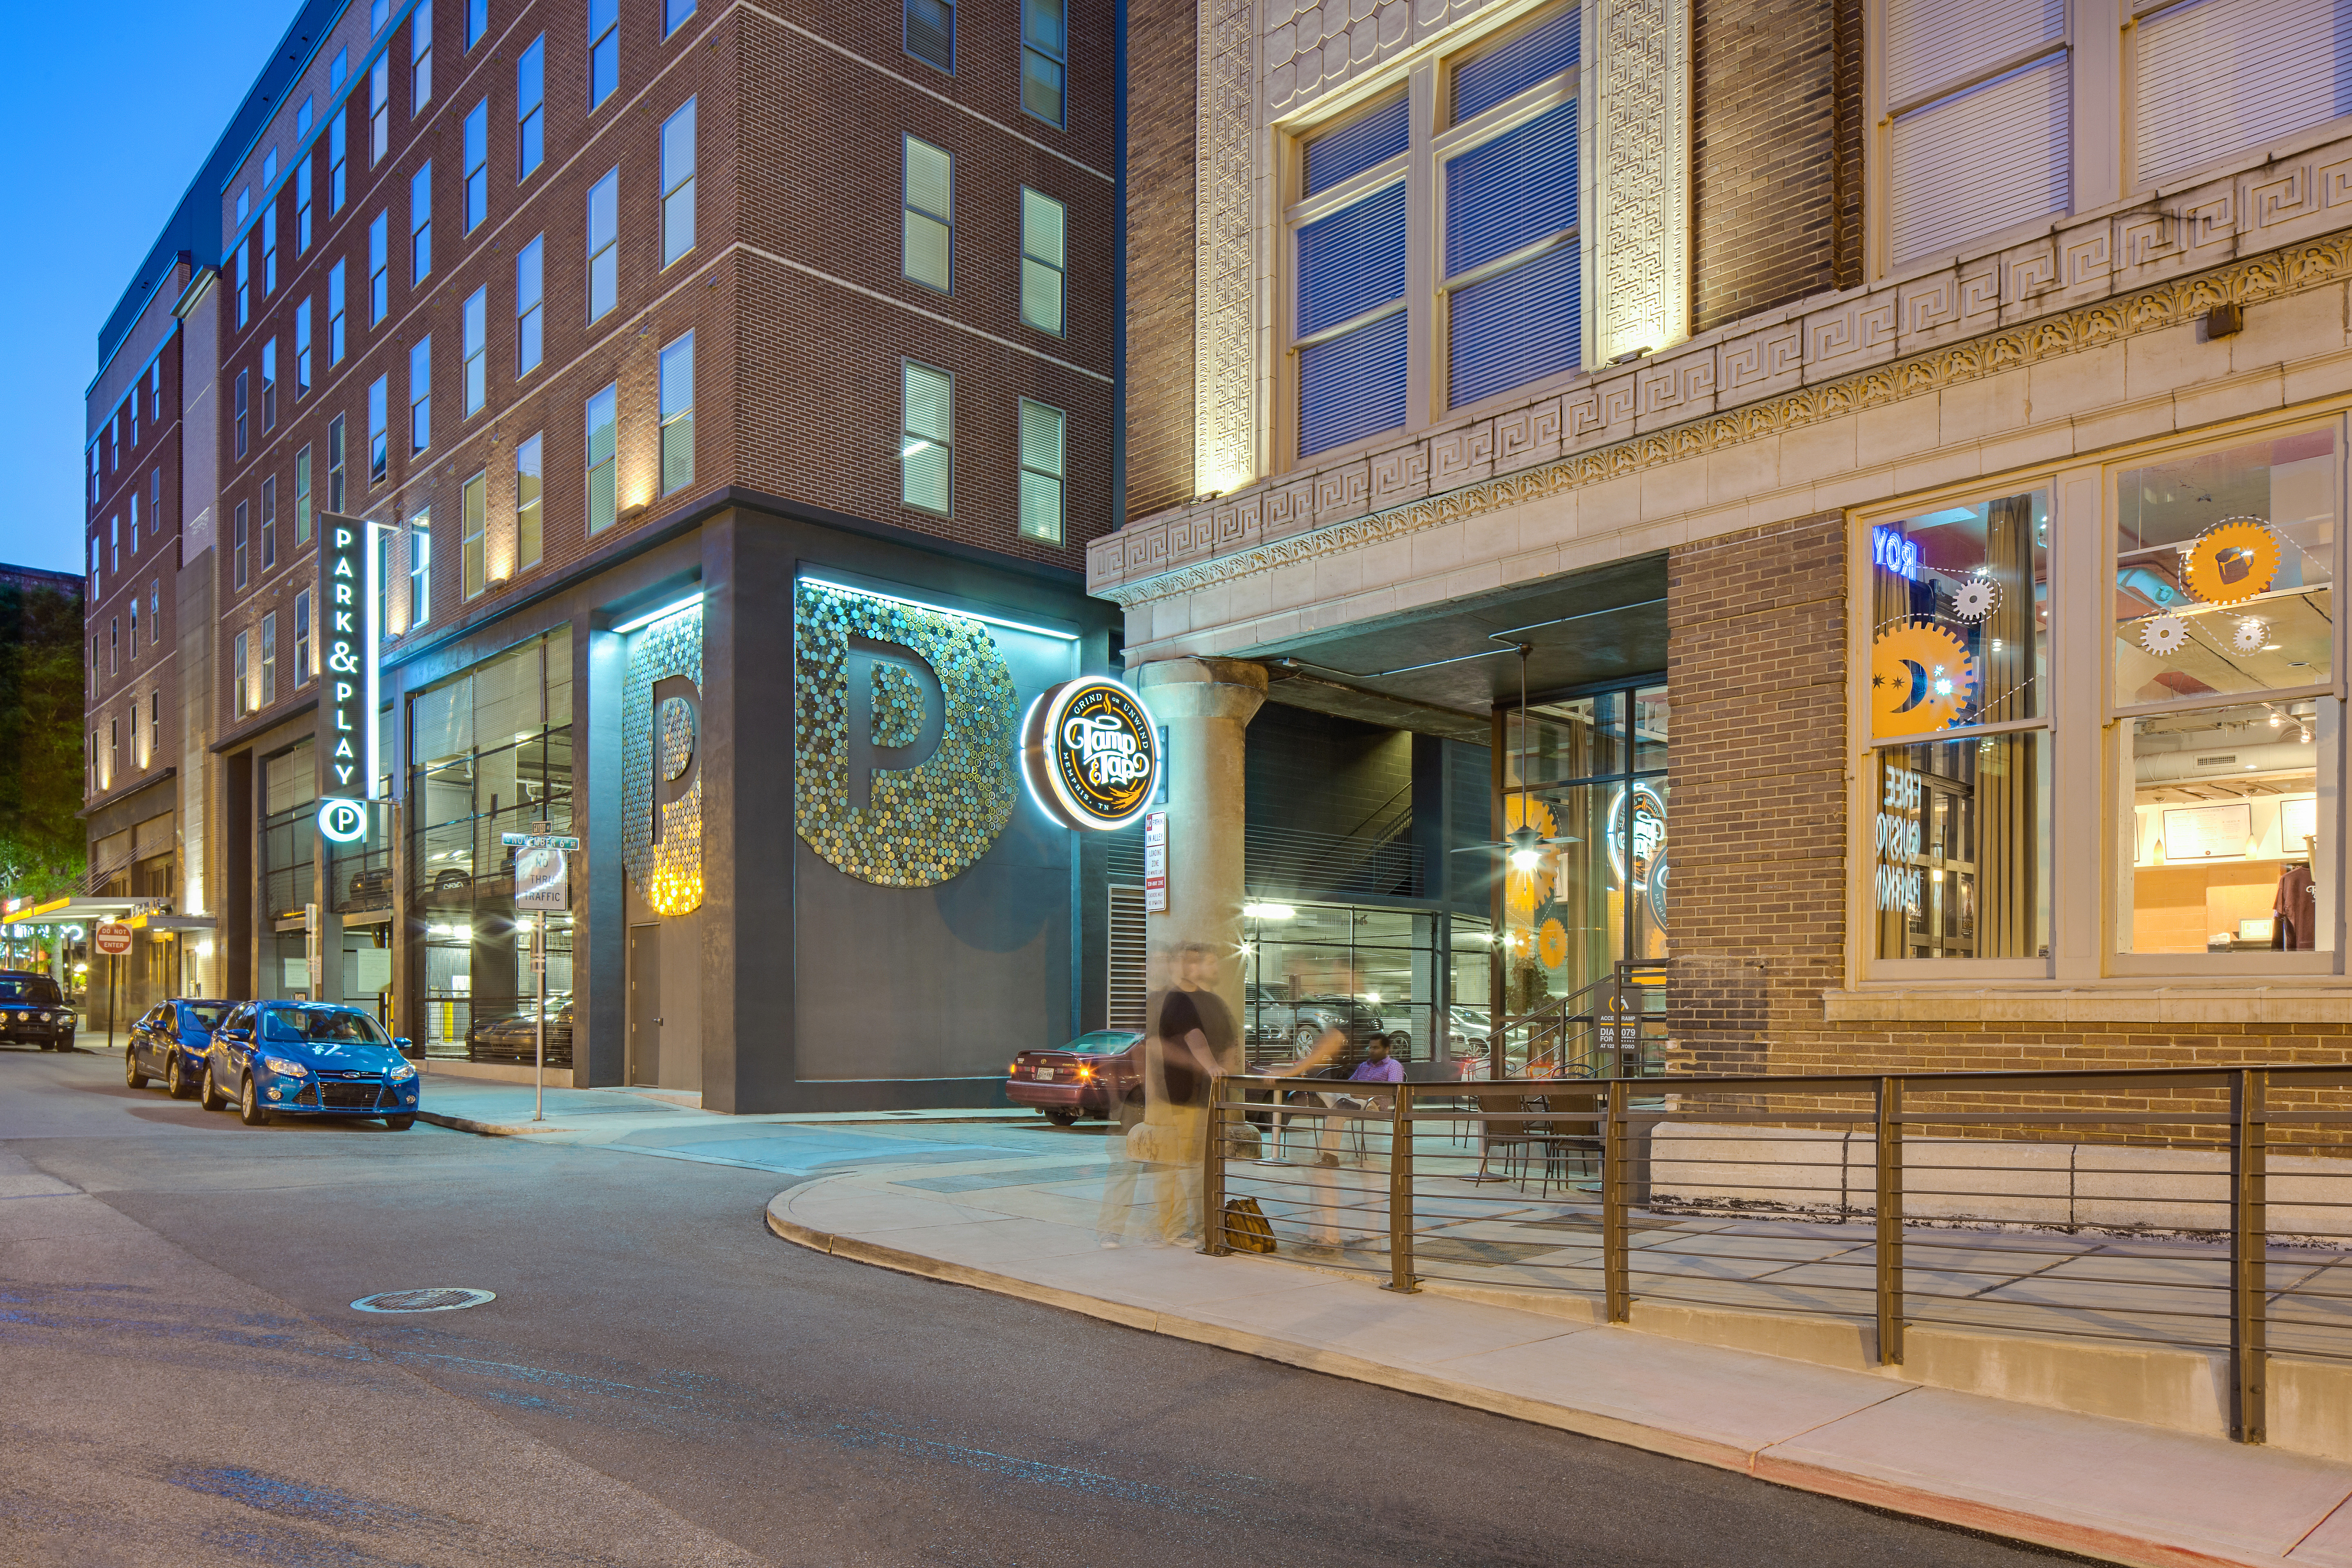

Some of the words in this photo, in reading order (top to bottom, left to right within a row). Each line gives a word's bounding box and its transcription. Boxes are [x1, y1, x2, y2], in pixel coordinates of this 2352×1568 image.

[1074, 693, 1102, 714] GRIND
[1123, 703, 1149, 749] UNWIND
[1064, 715, 1136, 761] Tamp
[1083, 750, 1150, 785] Tap
[1098, 803, 1109, 811] TN
[533, 823, 546, 833] GAYOSO
[1147, 819, 1152, 828] NO
[512, 837, 556, 847] NOVEMBER
[1152, 833, 1163, 842] ALLEY
[1149, 849, 1162, 857] LOADING
[536, 858, 548, 867] NO
[530, 875, 554, 884] THRU
[524, 891, 560, 901] TRAFFIC
[1600, 1028, 1615, 1036] DIA
